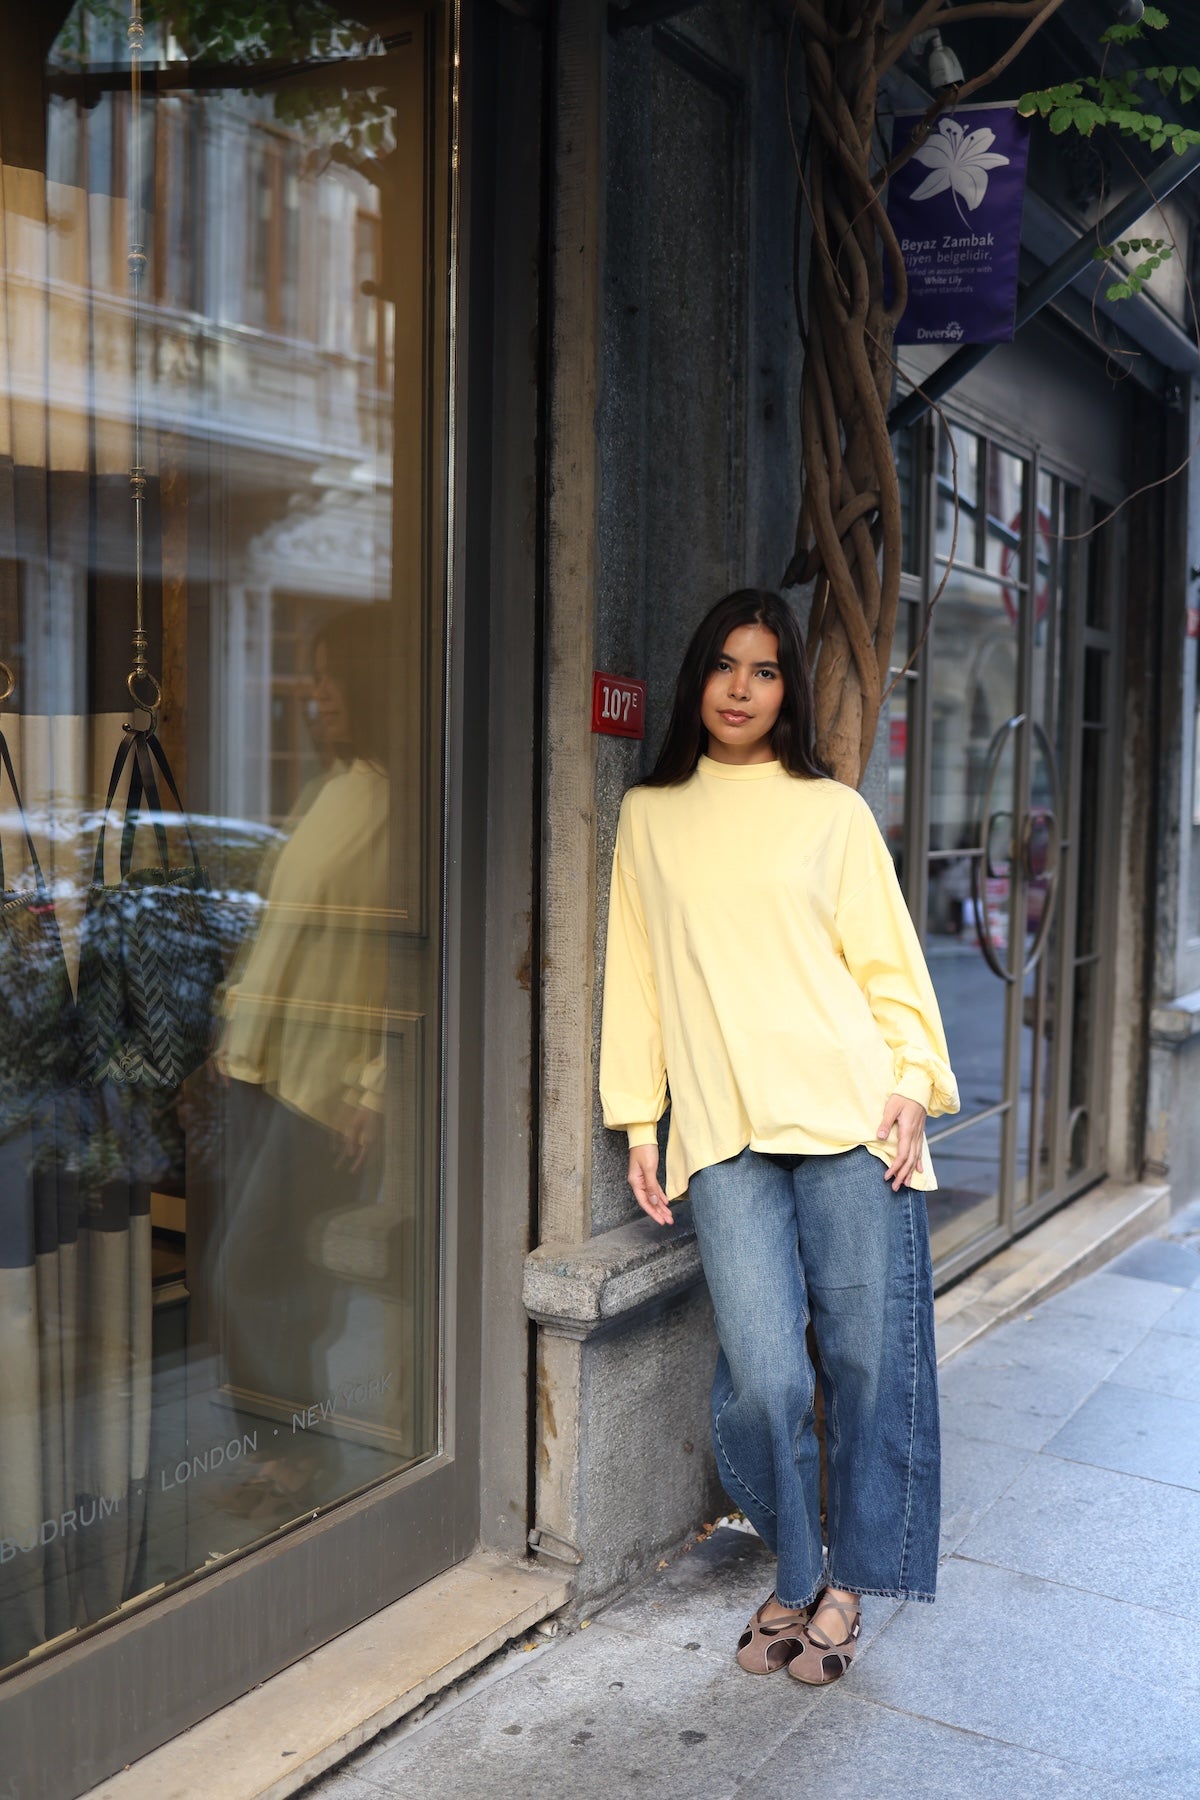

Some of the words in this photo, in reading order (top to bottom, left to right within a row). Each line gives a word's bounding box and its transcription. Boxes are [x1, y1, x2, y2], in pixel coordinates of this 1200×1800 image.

[901, 239, 937, 253] Beyaz
[942, 233, 994, 248] Zambak
[904, 254, 932, 266] ijyen
[936, 249, 993, 265] belgelidir.
[924, 276, 947, 285] White
[948, 275, 962, 287] Lily
[916, 328, 965, 341] Diversey
[0, 1495, 120, 1564] BODRUM
[161, 1431, 257, 1491] LONDON
[292, 1394, 339, 1434] NEW
[343, 1372, 393, 1409] YORK
